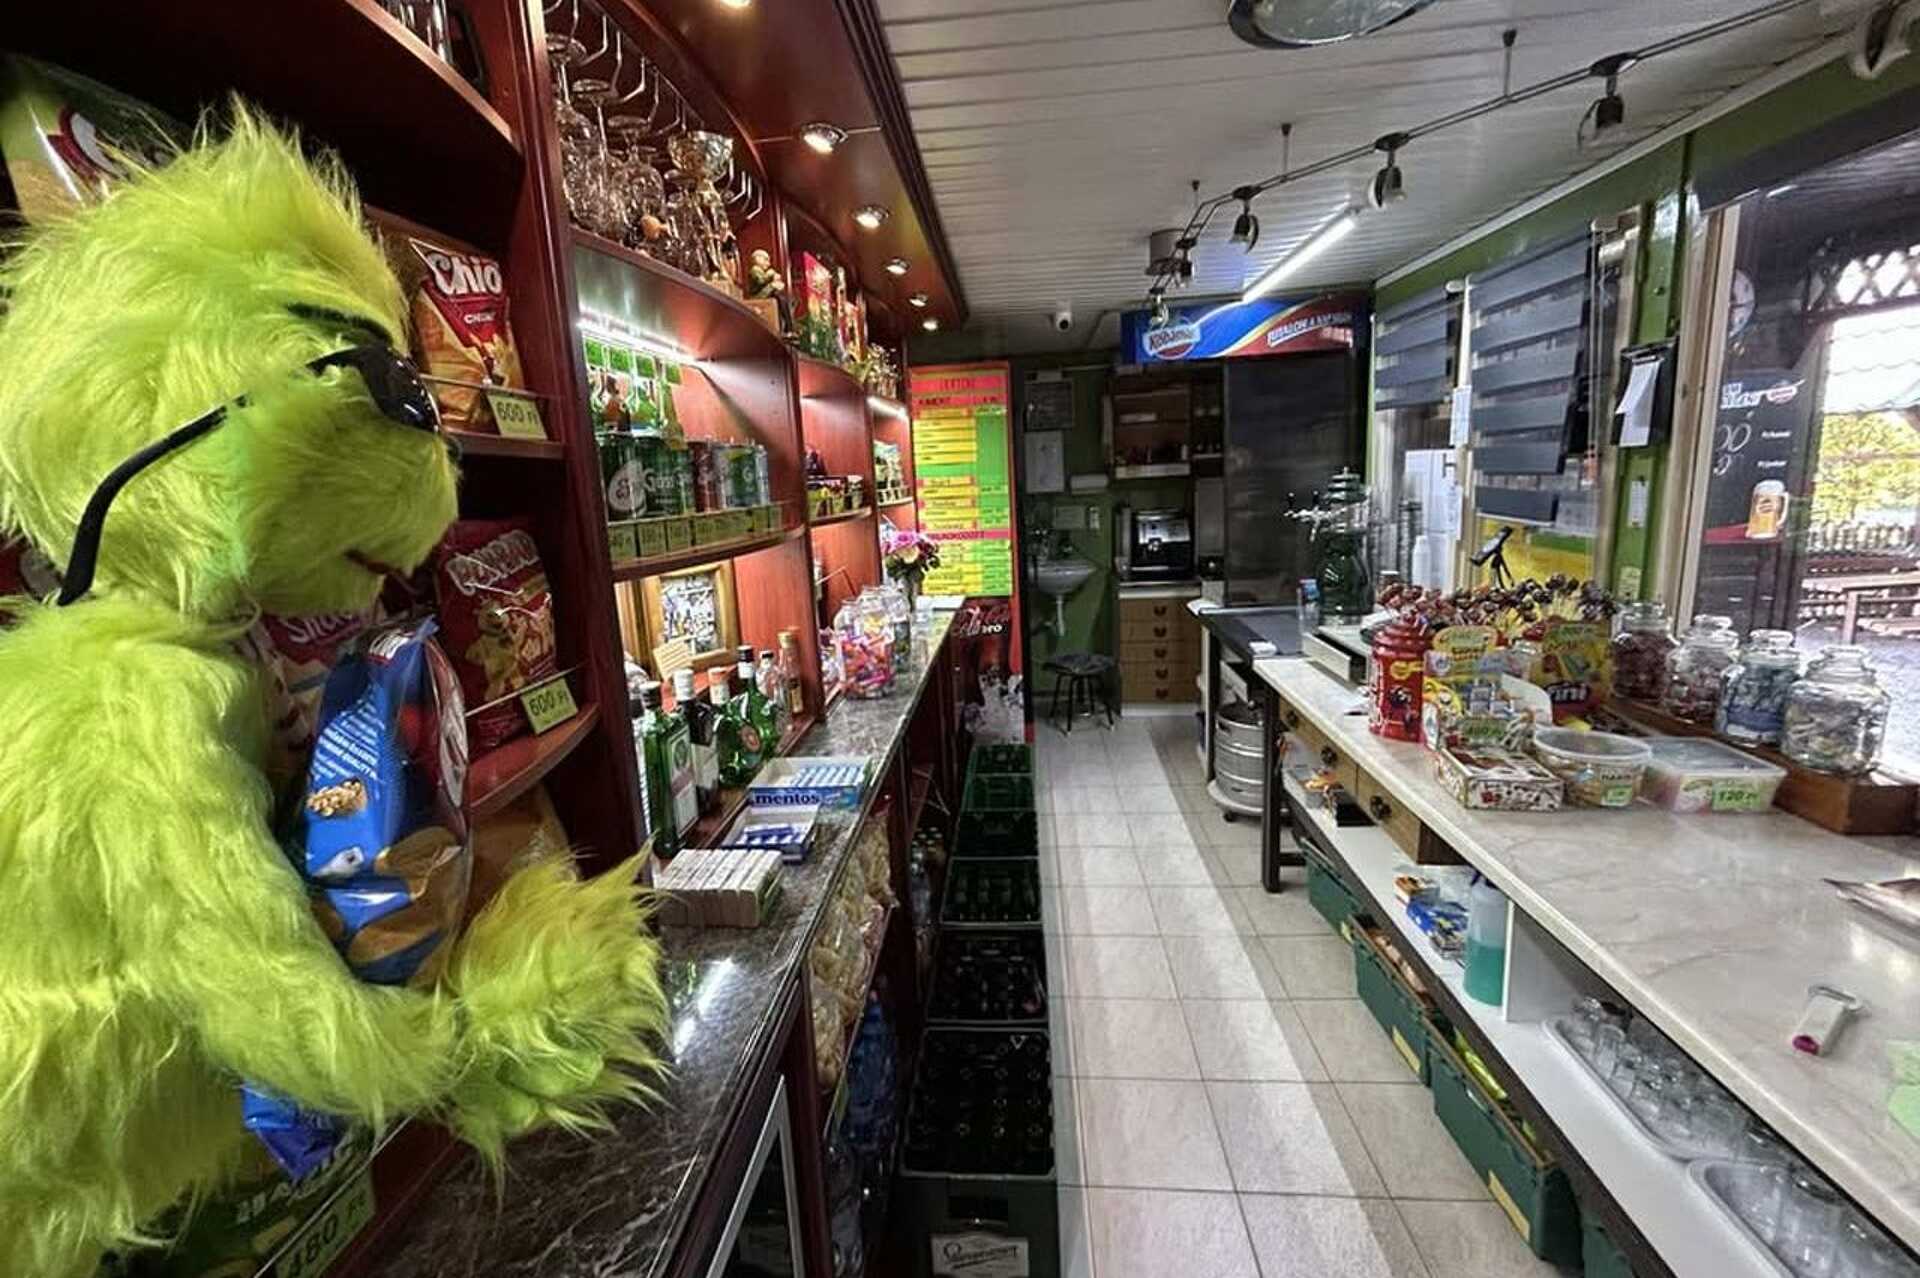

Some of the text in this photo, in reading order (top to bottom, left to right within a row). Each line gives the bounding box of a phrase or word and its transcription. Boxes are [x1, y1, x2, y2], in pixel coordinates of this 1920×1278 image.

[426, 252, 503, 295] Chio
[496, 401, 525, 422] 600
[528, 692, 557, 717] 600
[754, 793, 820, 806] mentos
[1719, 790, 1744, 801] 120
